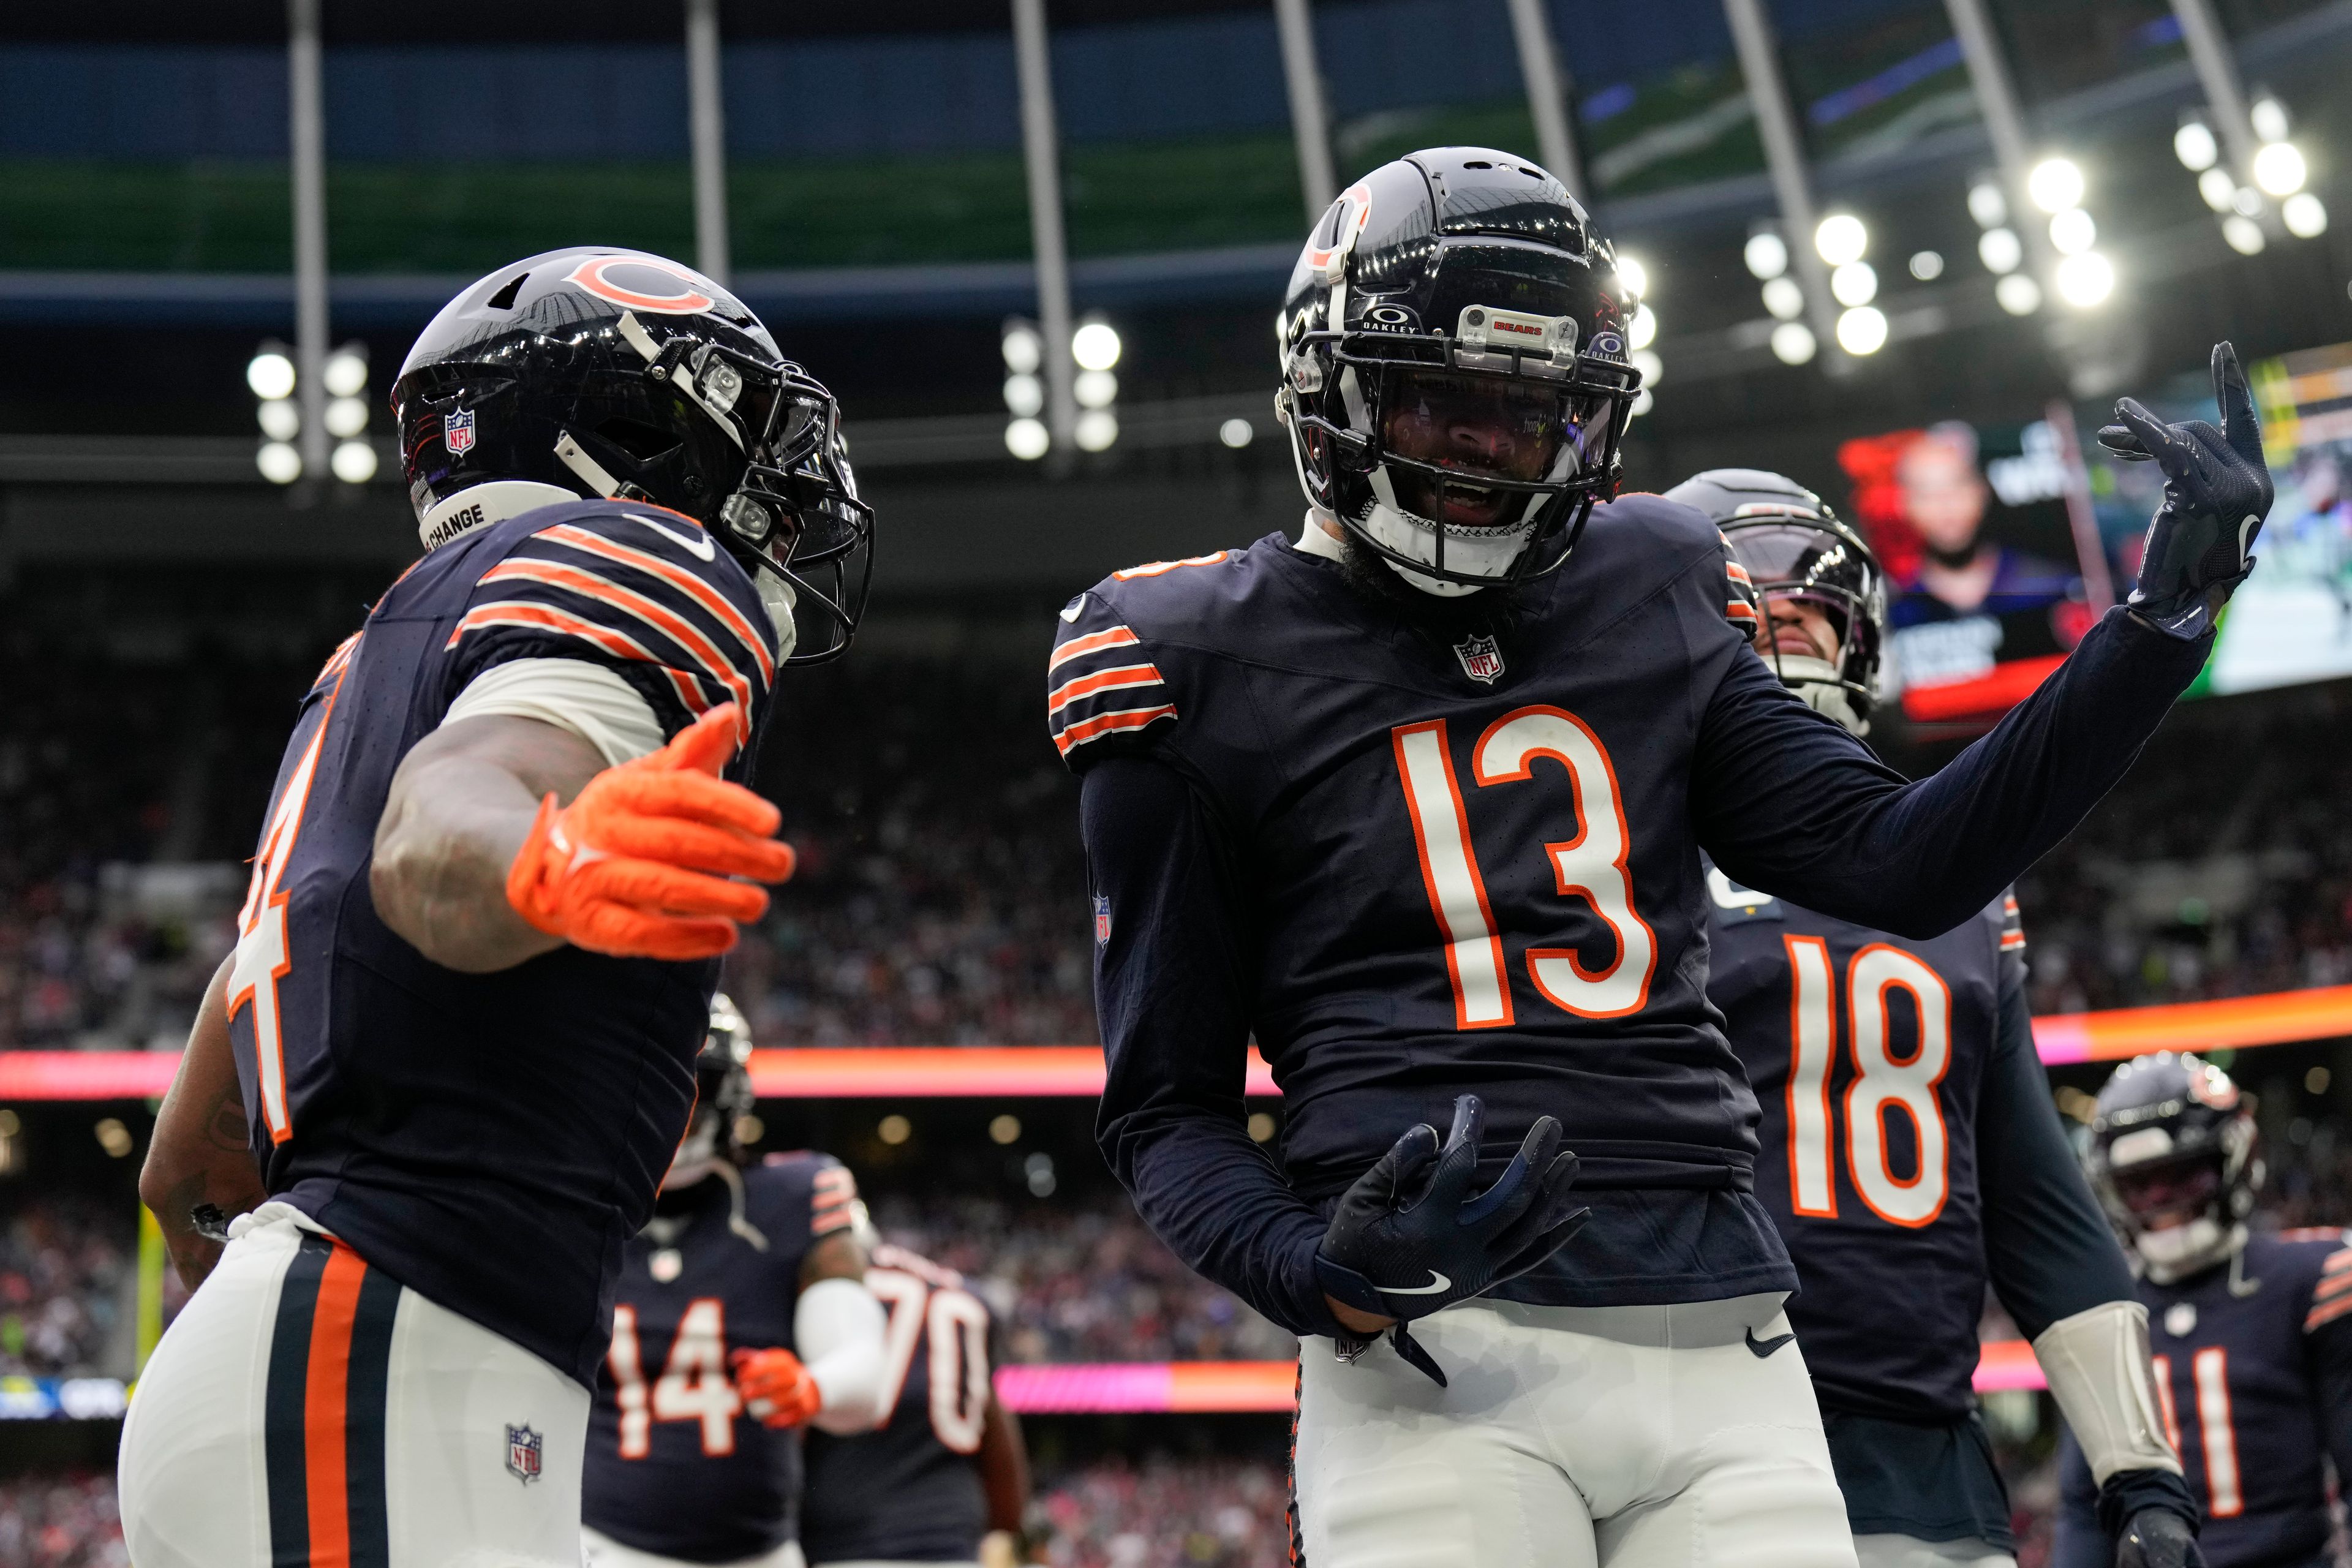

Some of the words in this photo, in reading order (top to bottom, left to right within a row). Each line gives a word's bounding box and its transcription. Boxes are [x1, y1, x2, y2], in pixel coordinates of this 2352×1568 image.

[1363, 322, 1416, 334] OAKLEY
[1494, 321, 1542, 336] BEARS
[450, 427, 471, 448] NFL
[429, 503, 484, 550] CHANGE
[1468, 654, 1499, 675] NFL
[1392, 704, 1657, 1031] 13
[225, 666, 347, 1148] 4
[1783, 933, 1952, 1228] 18
[608, 1297, 742, 1460] 14
[862, 1266, 989, 1455] 70
[513, 1446, 539, 1471] NFL
